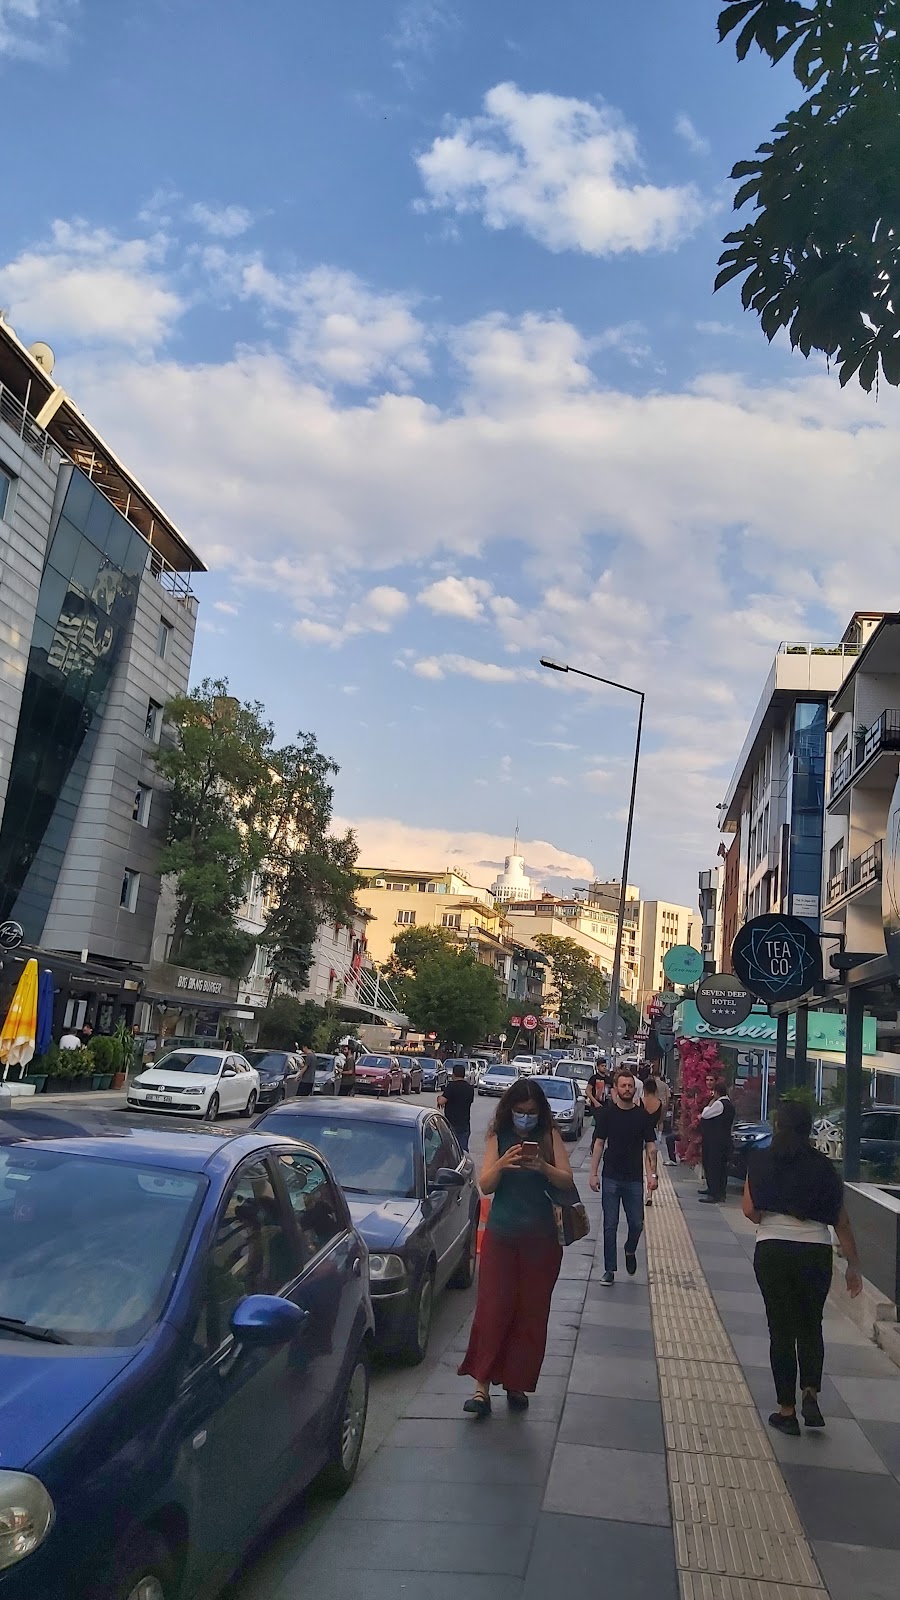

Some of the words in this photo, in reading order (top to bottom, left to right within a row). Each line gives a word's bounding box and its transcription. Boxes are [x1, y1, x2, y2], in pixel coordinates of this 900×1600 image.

[765, 941, 791, 958] TEA
[178, 975, 188, 989] BIG
[203, 980, 222, 994] BURGER
[701, 989, 726, 997] SEVEN
[711, 998, 737, 1006] HOTEL
